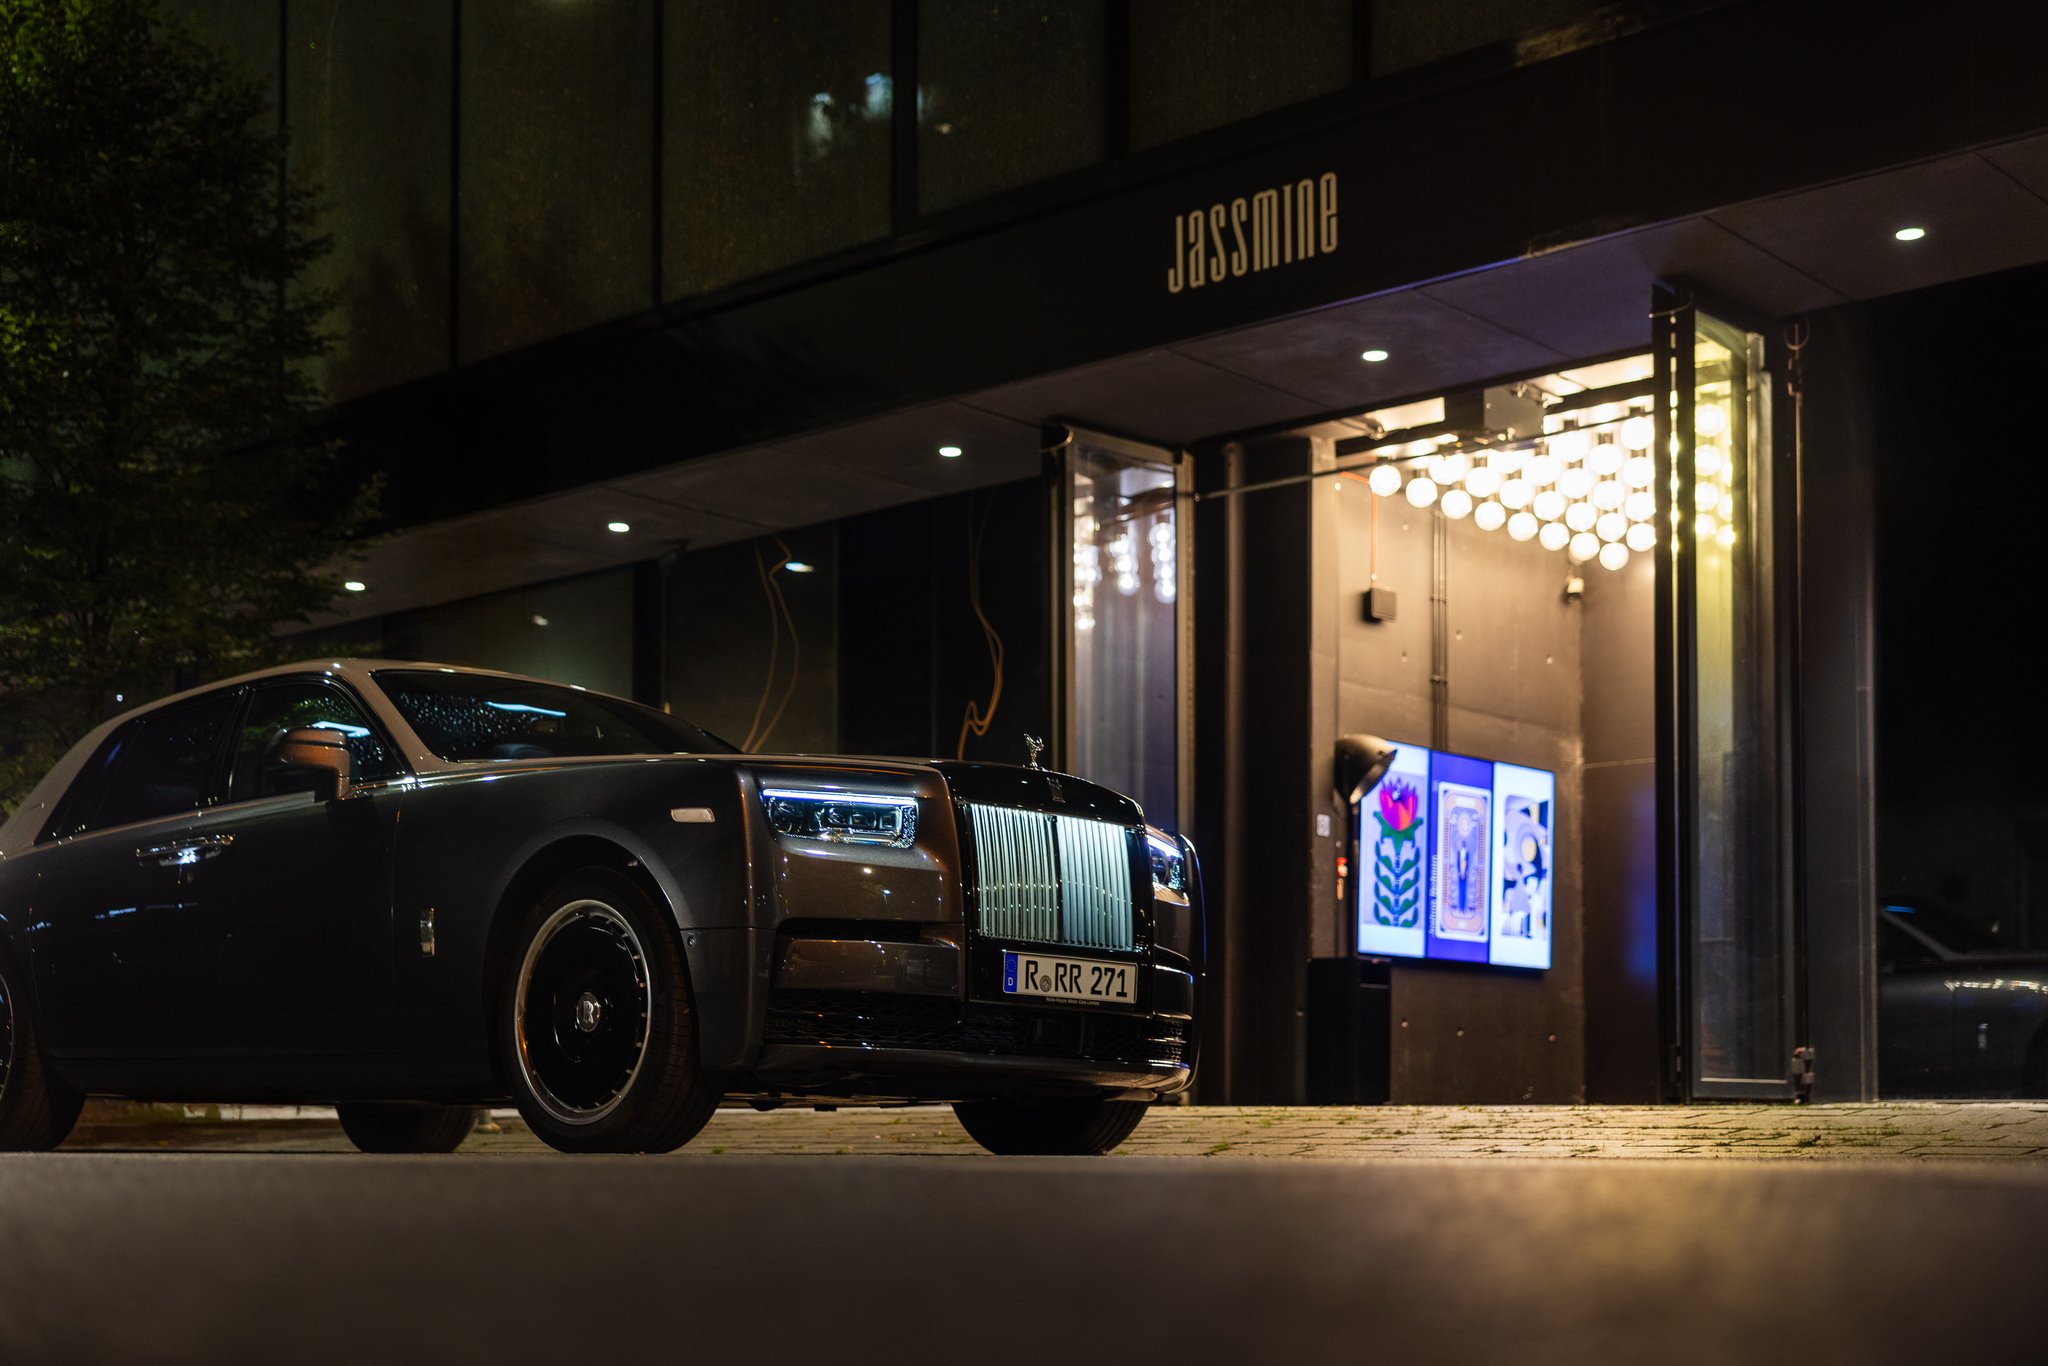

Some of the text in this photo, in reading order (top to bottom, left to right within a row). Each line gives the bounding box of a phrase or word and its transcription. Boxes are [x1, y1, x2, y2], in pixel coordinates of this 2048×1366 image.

[1007, 977, 1014, 986] D
[1025, 960, 1128, 998] R RR 271
